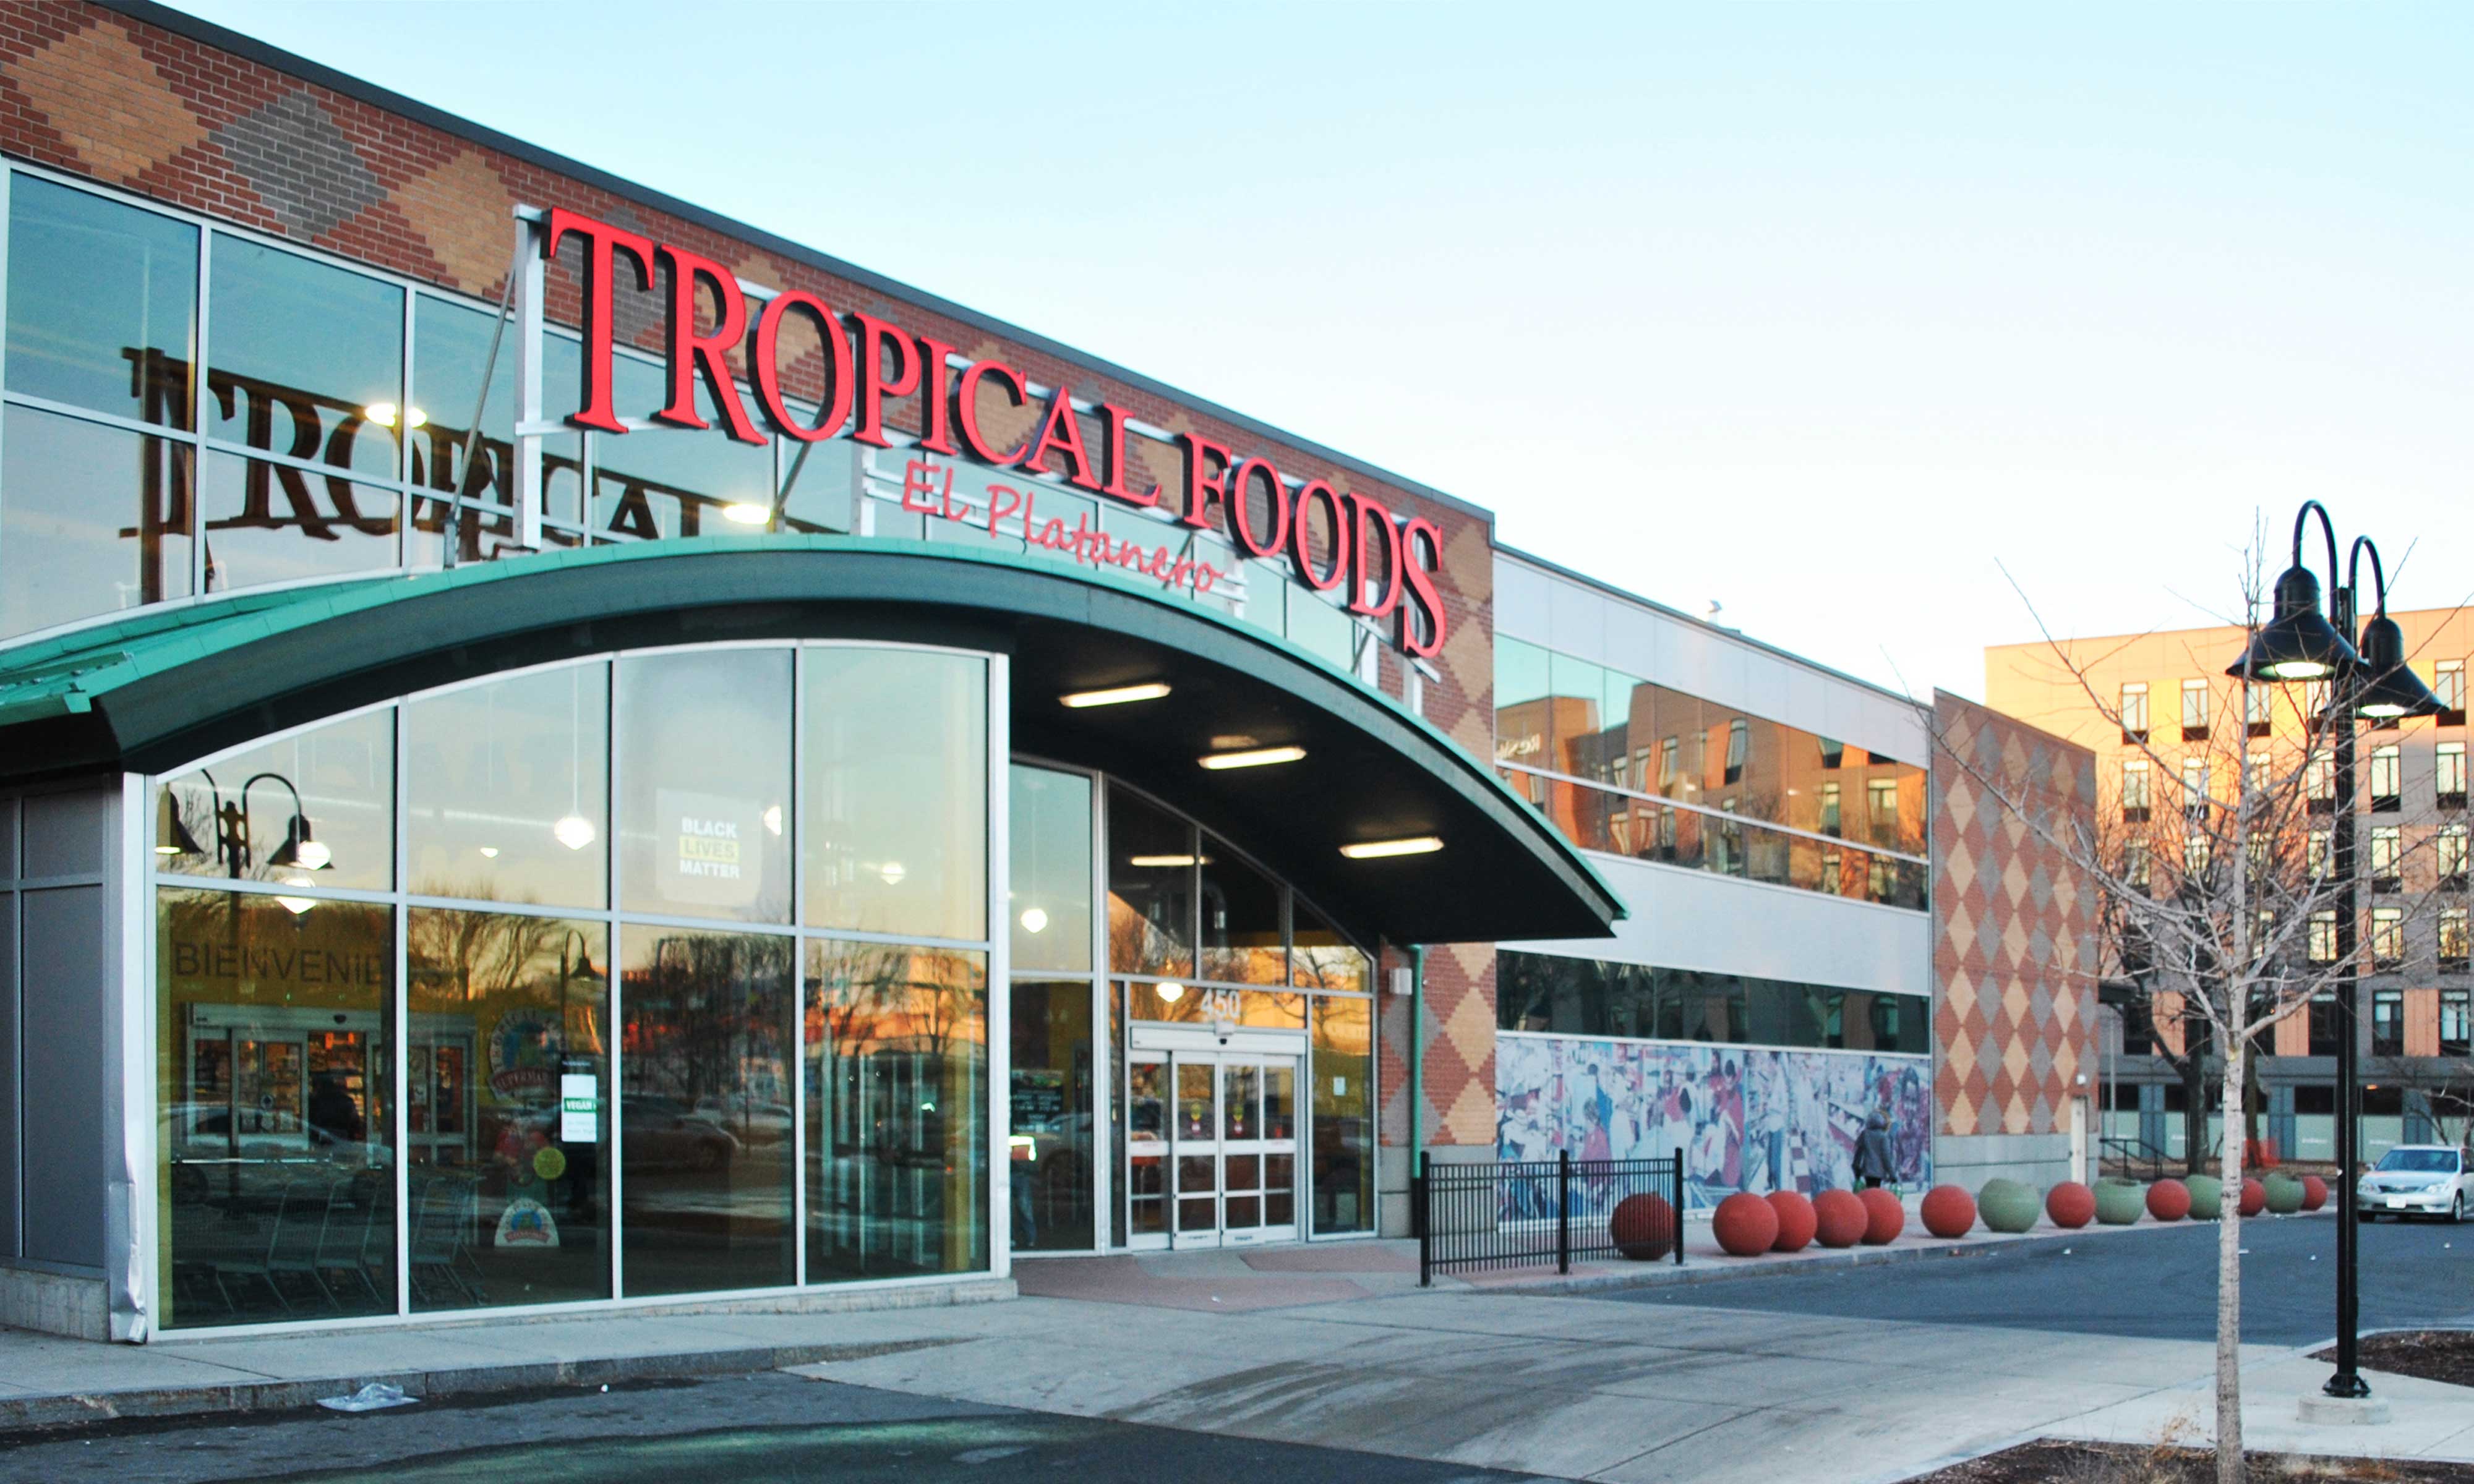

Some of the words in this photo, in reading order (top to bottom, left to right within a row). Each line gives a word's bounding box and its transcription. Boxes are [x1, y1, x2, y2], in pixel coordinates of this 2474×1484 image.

[542, 207, 1160, 507] TROPICAL
[1180, 431, 1444, 659] FOODS
[987, 484, 1225, 593] Platanero
[682, 817, 737, 837] BLACK
[685, 838, 735, 858] LIVES
[680, 859, 739, 878] MATTER
[1200, 989, 1241, 1019] 450
[566, 1100, 592, 1111] VEGAN
